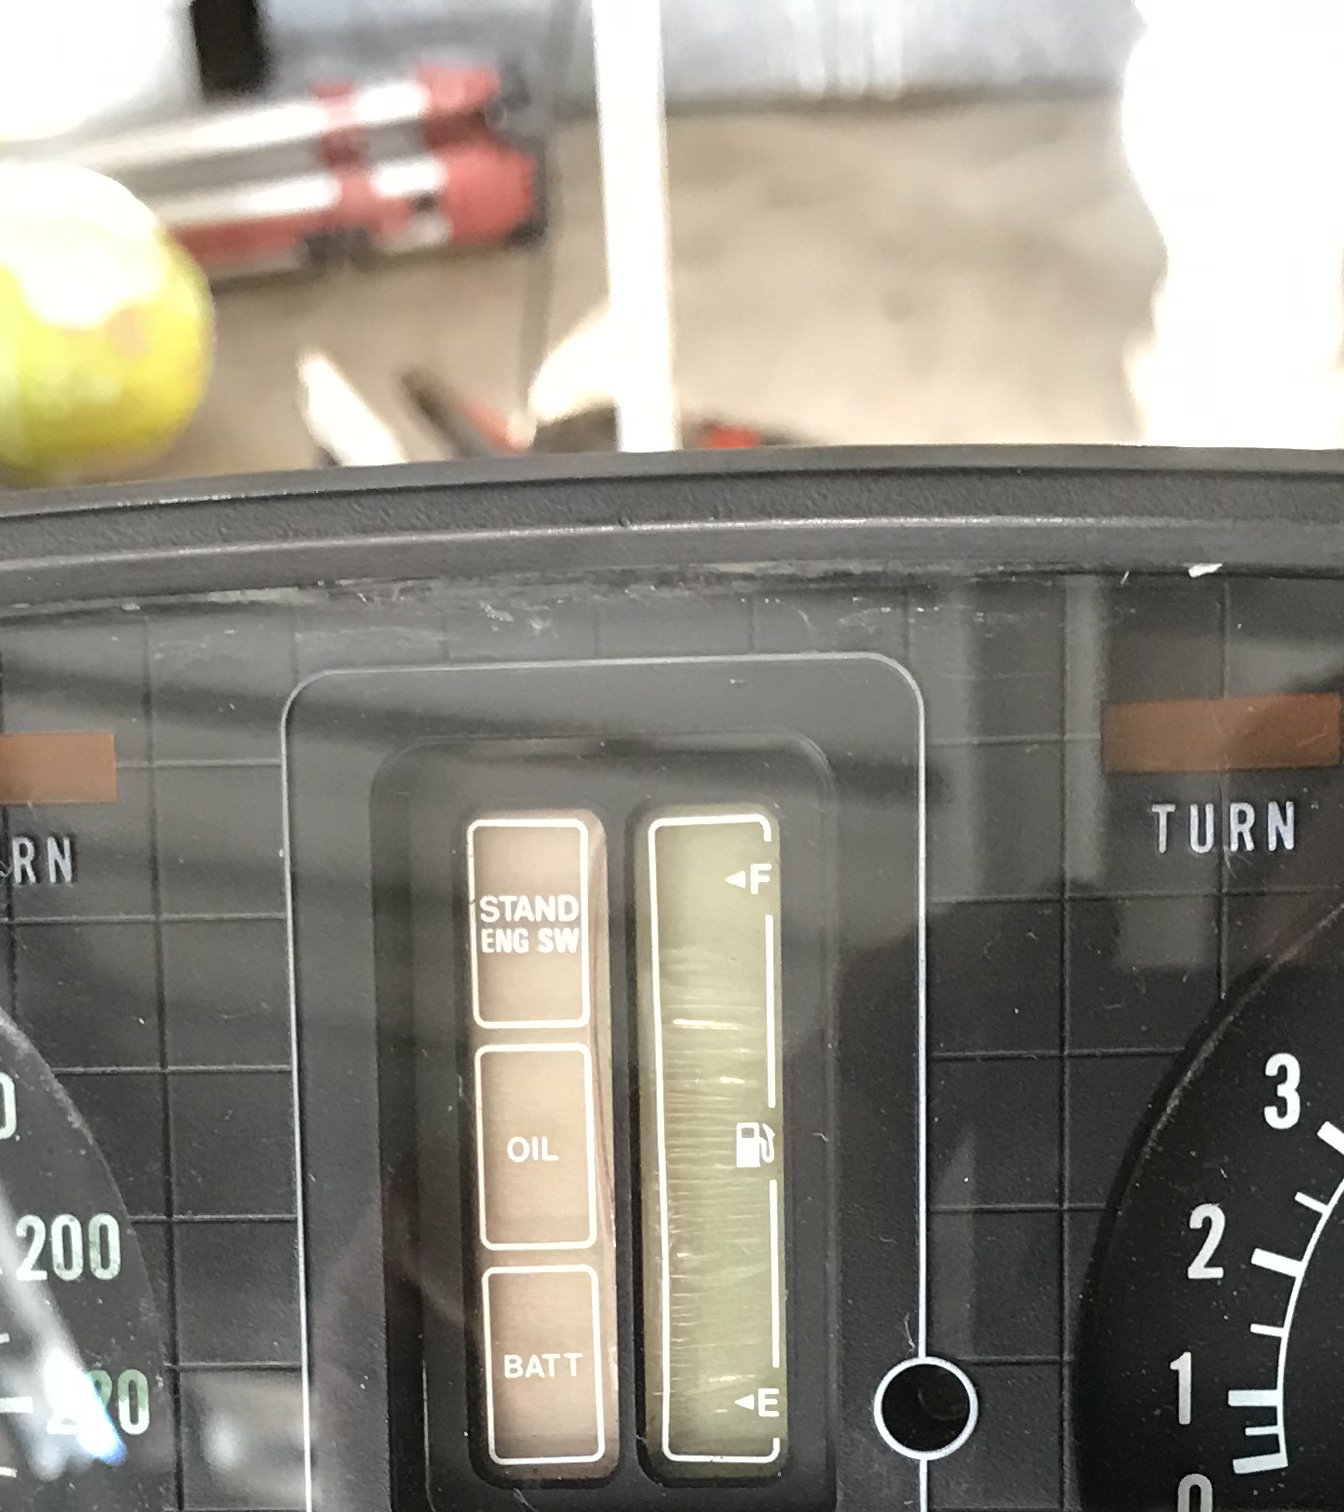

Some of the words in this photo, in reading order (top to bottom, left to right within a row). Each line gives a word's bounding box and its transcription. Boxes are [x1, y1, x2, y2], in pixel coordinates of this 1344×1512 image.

[1151, 801, 1296, 854] TURN
[749, 863, 773, 895] F
[479, 894, 580, 923] STAND
[480, 928, 530, 954] ENG
[538, 928, 580, 953] SW
[1263, 1052, 1301, 1130] 3
[506, 1136, 560, 1164] OIL
[14, 1212, 122, 1282] 200
[1186, 1202, 1226, 1280] 2
[503, 1352, 583, 1379] BATT
[757, 1387, 781, 1418] E
[1169, 1351, 1193, 1425] 1
